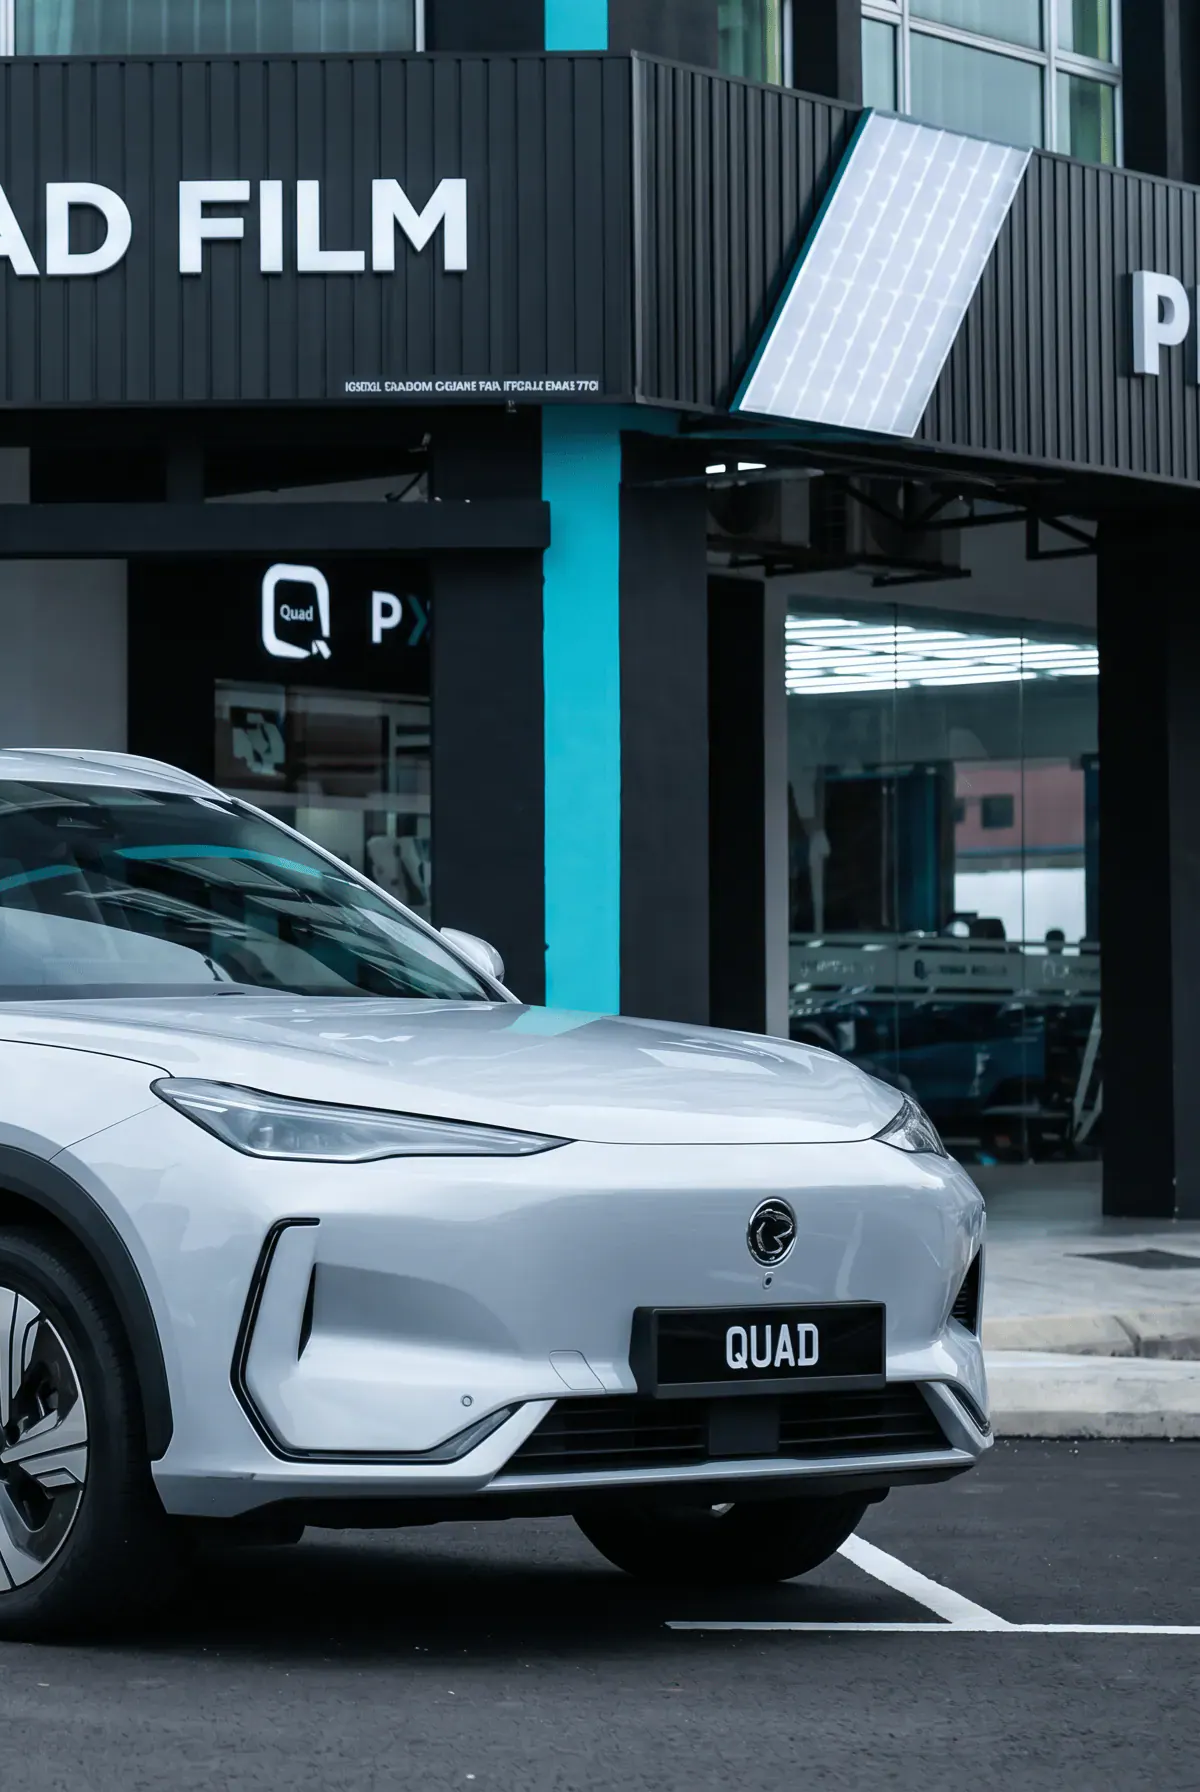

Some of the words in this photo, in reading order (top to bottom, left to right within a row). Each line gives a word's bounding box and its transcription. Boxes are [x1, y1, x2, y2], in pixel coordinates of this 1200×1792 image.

[179, 178, 468, 275] FILM
[1132, 270, 1200, 384] P
[279, 603, 314, 622] Quad
[726, 1323, 819, 1369] QUAD
